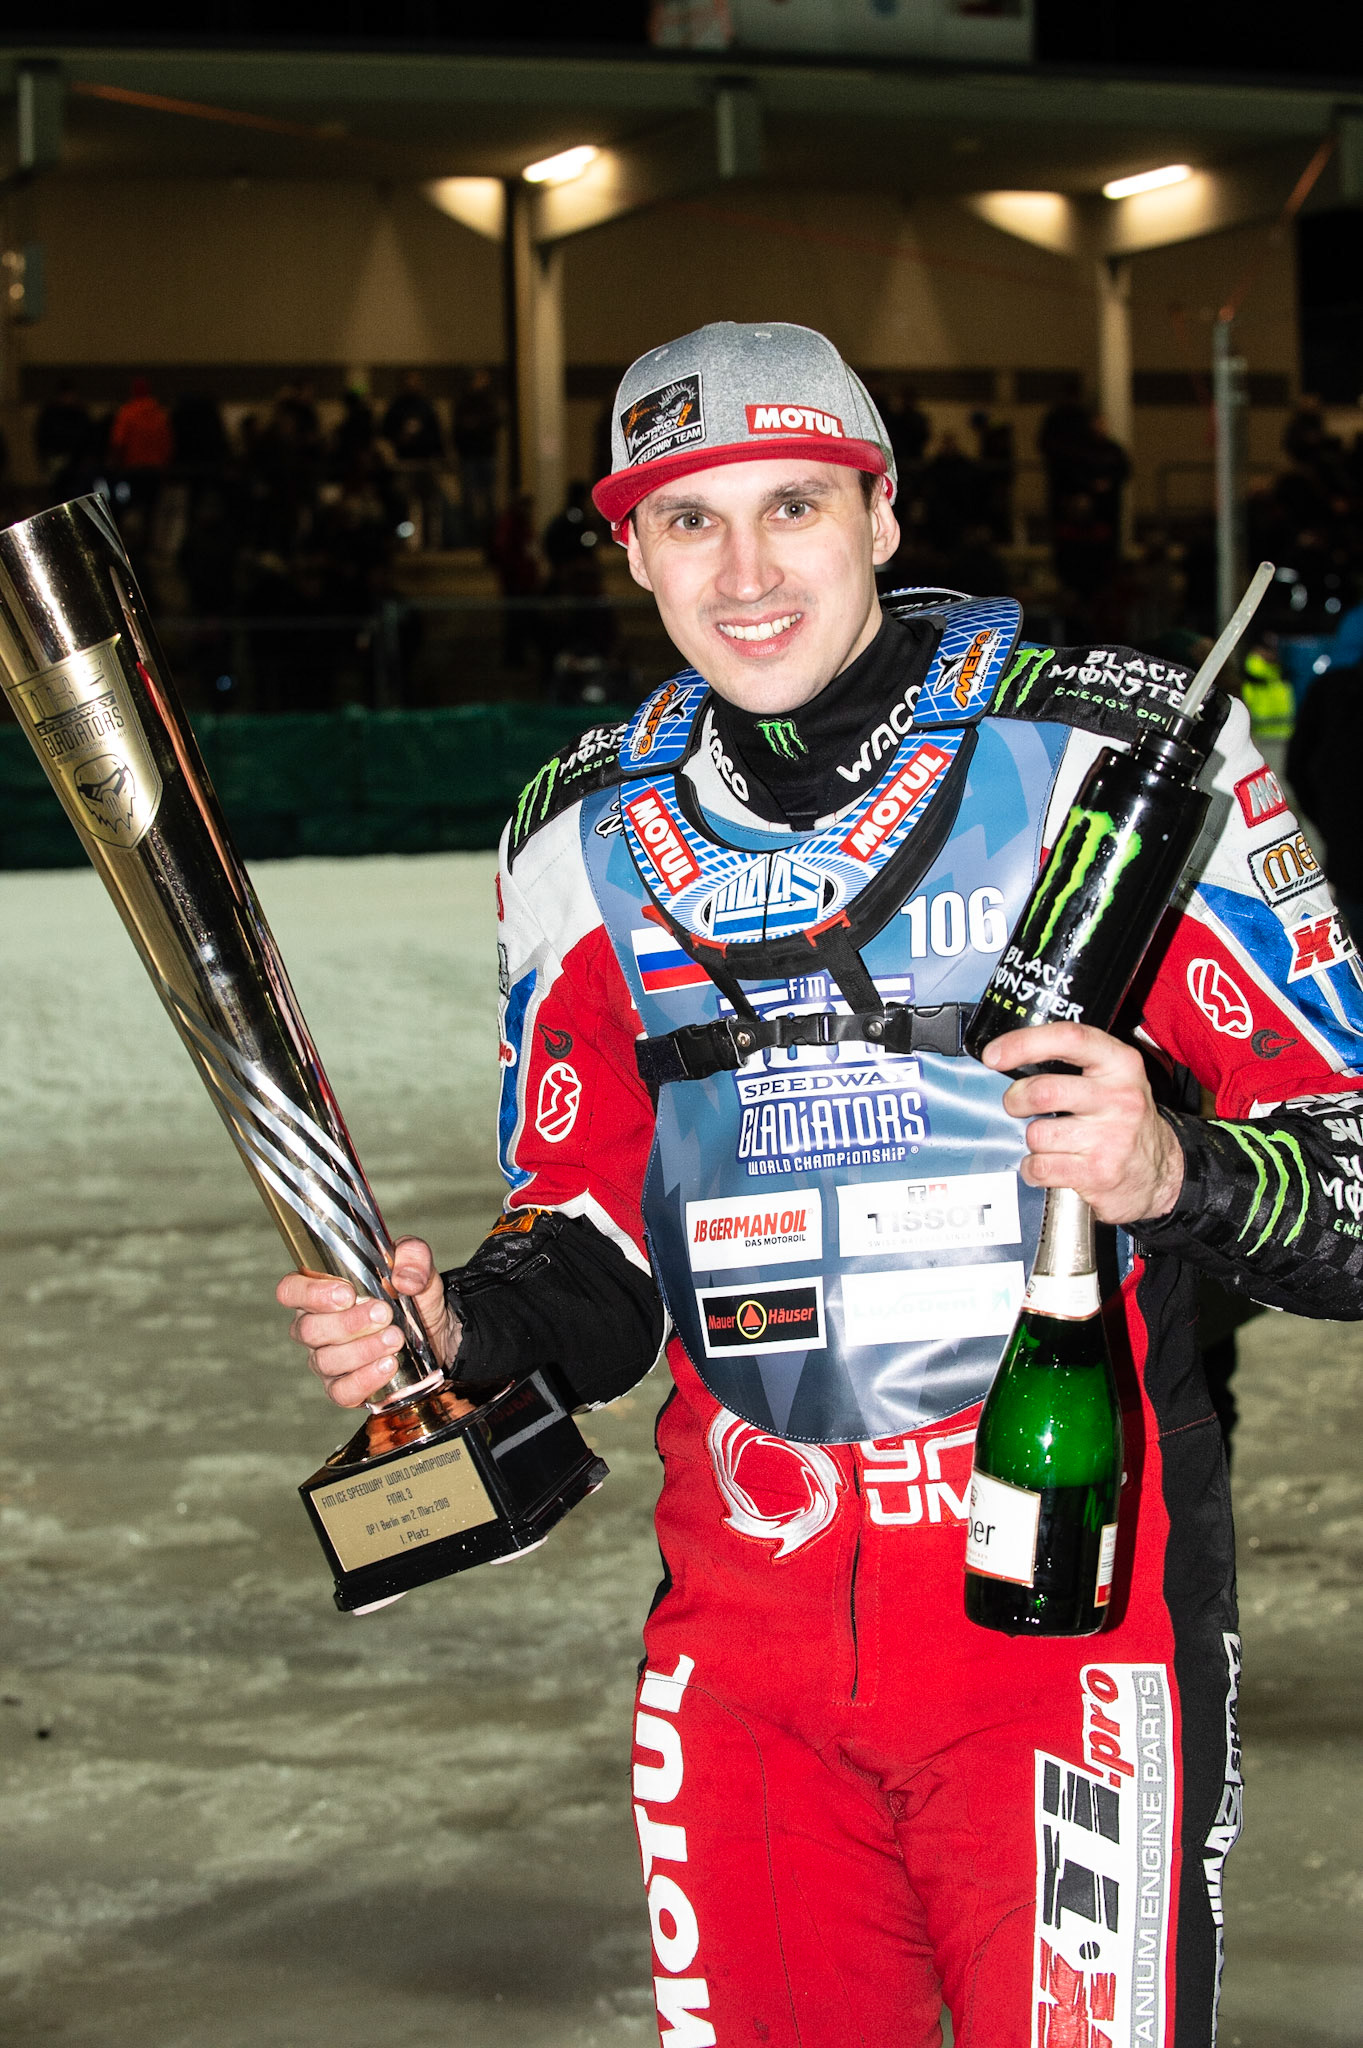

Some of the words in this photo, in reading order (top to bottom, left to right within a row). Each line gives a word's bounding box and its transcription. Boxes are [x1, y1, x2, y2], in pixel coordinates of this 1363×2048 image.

[633, 437, 673, 465] PEEDWAY
[674, 426, 701, 444] TEAM
[754, 407, 842, 438] MOTUL
[955, 631, 991, 708] MEFO
[1049, 664, 1204, 721] MONSTE
[1085, 650, 1188, 691] BLACK
[638, 683, 677, 755] MEFO
[1054, 687, 1128, 711] ENERGY
[851, 753, 944, 857] MOTUL
[631, 797, 693, 888] MOTUL
[900, 886, 1008, 958] 106
[991, 964, 1084, 1023] ONSTER
[1003, 945, 1074, 995] BLACK
[745, 1068, 914, 1098] SPEEDWAY
[738, 1092, 925, 1158] GLADIATORS
[748, 1160, 791, 1176] WORLD
[745, 1239, 762, 1248] DAS
[763, 1234, 806, 1246] MOTOROIL
[867, 1204, 991, 1234] TISSOT
[708, 1315, 737, 1330] Mauer
[768, 1307, 815, 1324] Häuser
[335, 1490, 348, 1504] ICE
[346, 1477, 384, 1500] SPEEDWAY
[384, 1467, 411, 1486] WORLD
[410, 1448, 462, 1477] CHAMPIONSHIP
[386, 1490, 407, 1506] FINAL
[405, 1487, 413, 1499] 3
[380, 1517, 400, 1531] Berlin
[401, 1514, 411, 1523] am
[433, 1497, 450, 1512] 2019
[407, 1528, 431, 1542] Platz
[1139, 1676, 1162, 1782] PARTS
[632, 1654, 717, 2048] MOTUL
[1140, 1792, 1163, 1918] ENGINE
